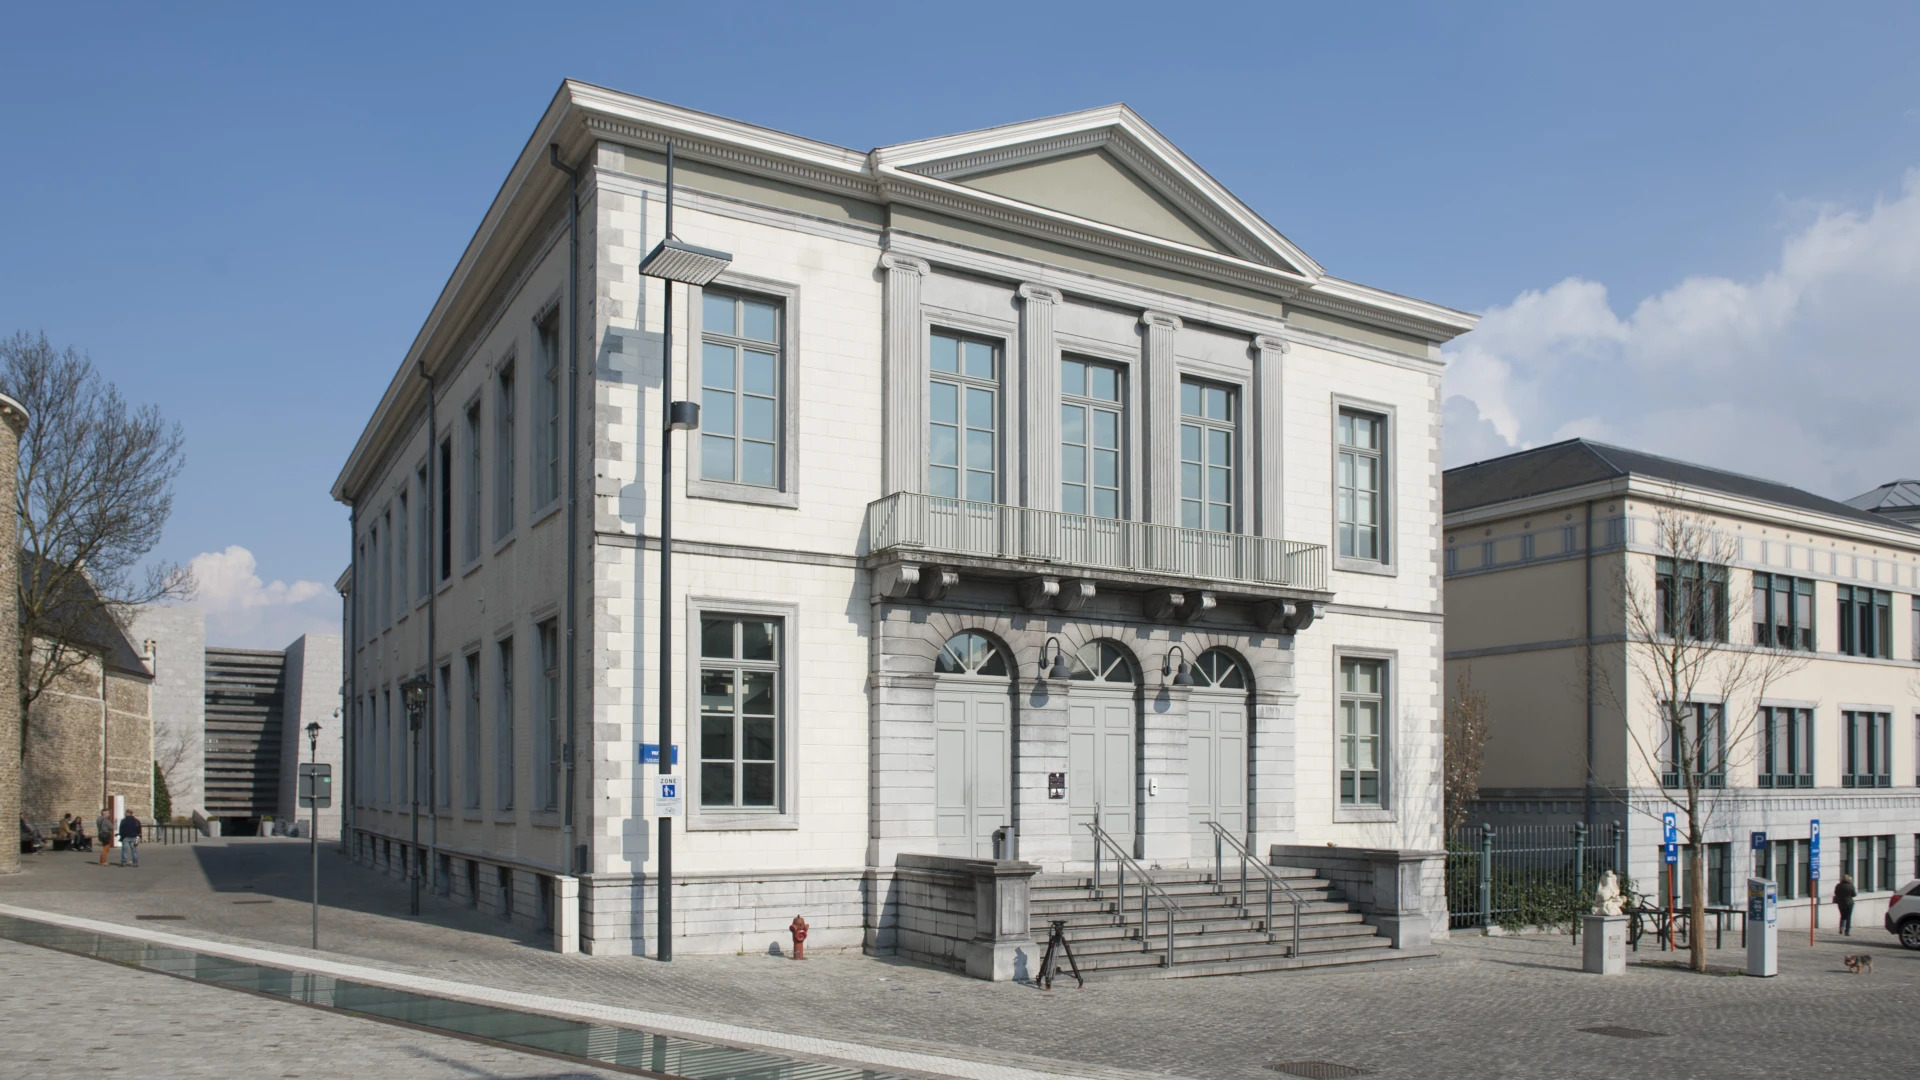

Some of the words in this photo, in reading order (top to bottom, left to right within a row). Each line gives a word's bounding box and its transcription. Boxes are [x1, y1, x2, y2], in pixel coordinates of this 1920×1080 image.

[1665, 816, 1674, 837] P
[1812, 823, 1819, 842] P
[1755, 835, 1764, 846] P
